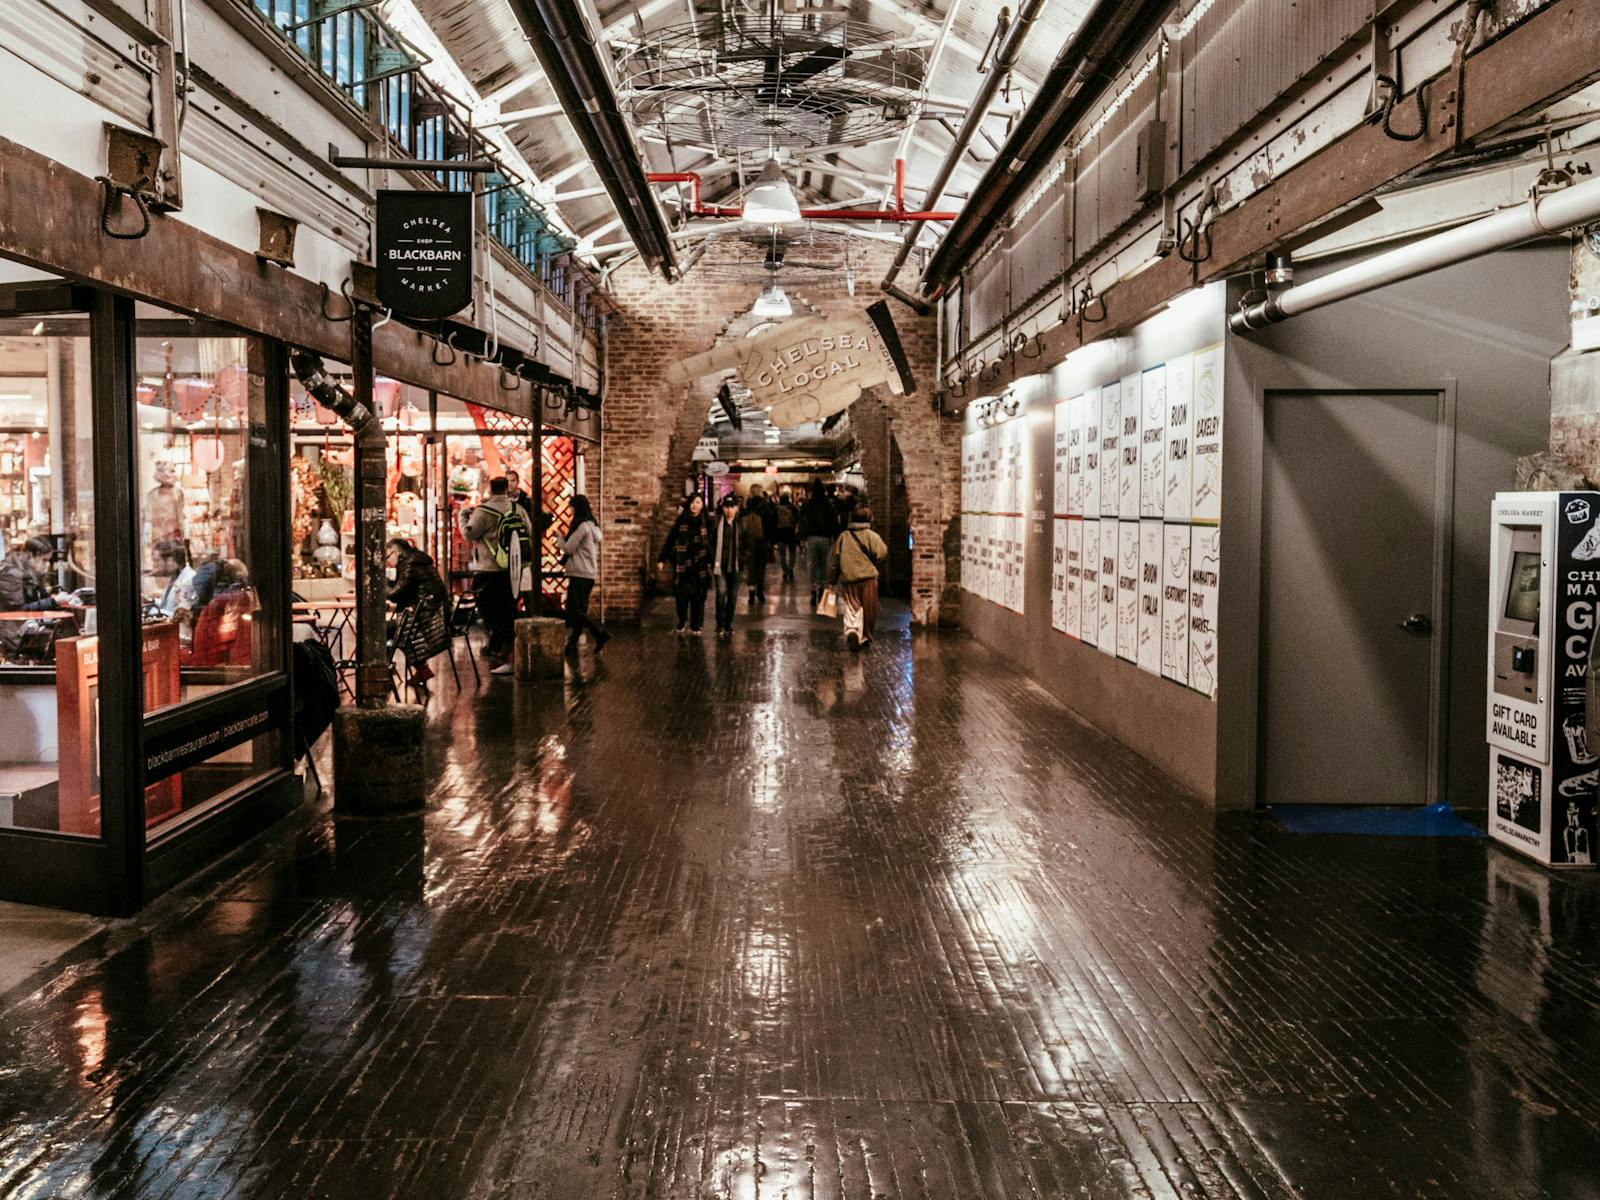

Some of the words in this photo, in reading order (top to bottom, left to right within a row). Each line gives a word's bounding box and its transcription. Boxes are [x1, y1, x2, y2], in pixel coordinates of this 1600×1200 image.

[403, 217, 451, 233] CHELSEA
[389, 249, 462, 261] BLACKBARN
[401, 278, 448, 292] MARKET
[866, 319, 880, 339] THE
[758, 335, 871, 387] CHELSEA
[879, 343, 897, 373] SHOP
[779, 356, 861, 394] LOCAL
[1171, 403, 1187, 427] BUON
[1169, 437, 1188, 461] ITALIA
[1143, 562, 1158, 584] BUON
[1493, 703, 1512, 721] GIFT
[1513, 710, 1537, 730] CARD
[1492, 721, 1537, 748] AVAILABLE
